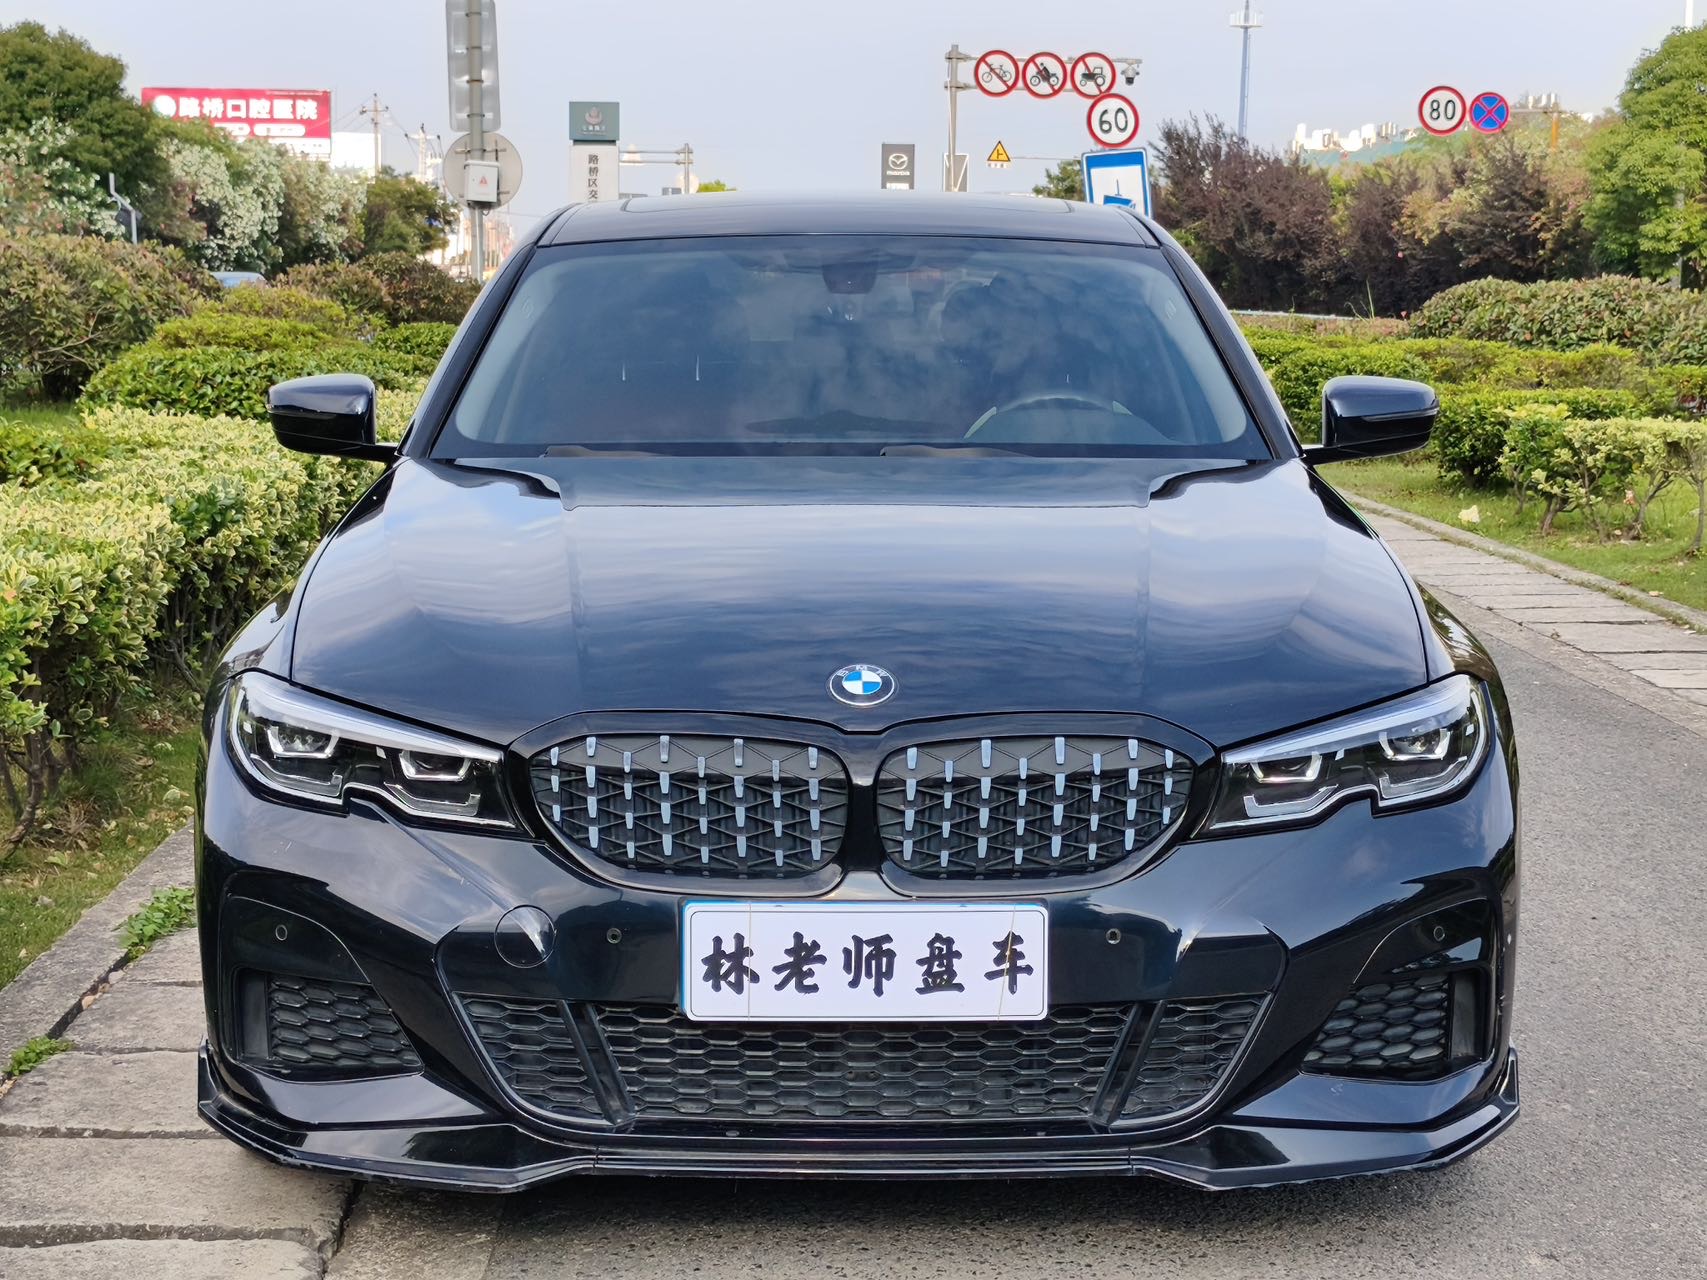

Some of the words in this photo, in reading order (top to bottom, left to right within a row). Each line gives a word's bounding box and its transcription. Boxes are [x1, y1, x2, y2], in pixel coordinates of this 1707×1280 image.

[178, 97, 318, 120] 路桥口腔医院
[1098, 107, 1128, 134] 60
[1430, 99, 1456, 120] 80
[587, 154, 599, 201] 路桥区交
[837, 664, 889, 677] BMW
[701, 929, 1035, 998] 林老师盘车
